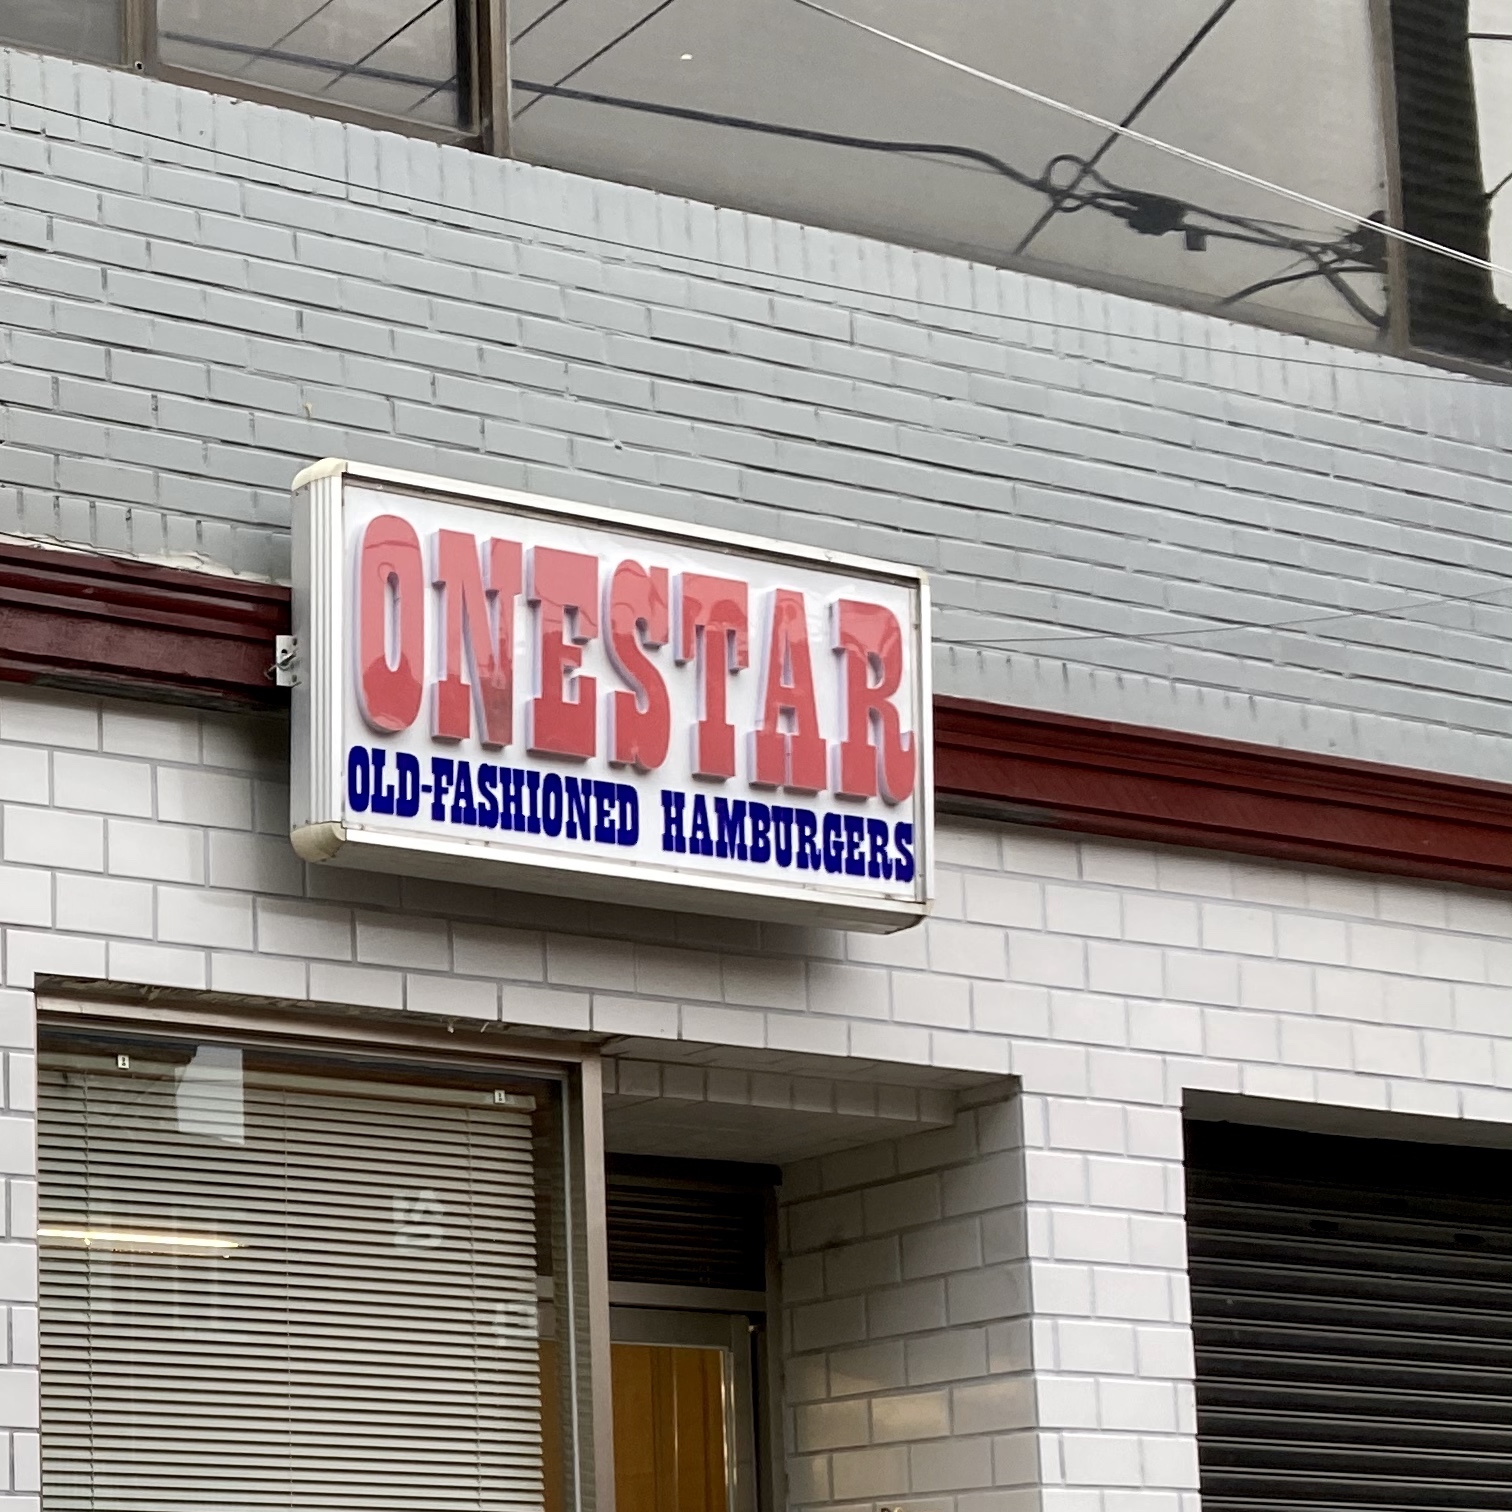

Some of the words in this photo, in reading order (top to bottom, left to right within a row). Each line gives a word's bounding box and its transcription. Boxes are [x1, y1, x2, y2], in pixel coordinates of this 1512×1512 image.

[358, 514, 917, 803] ONESTAR
[348, 745, 639, 846] OLD-FASHIONED
[661, 790, 915, 882] HAMBURGERS
